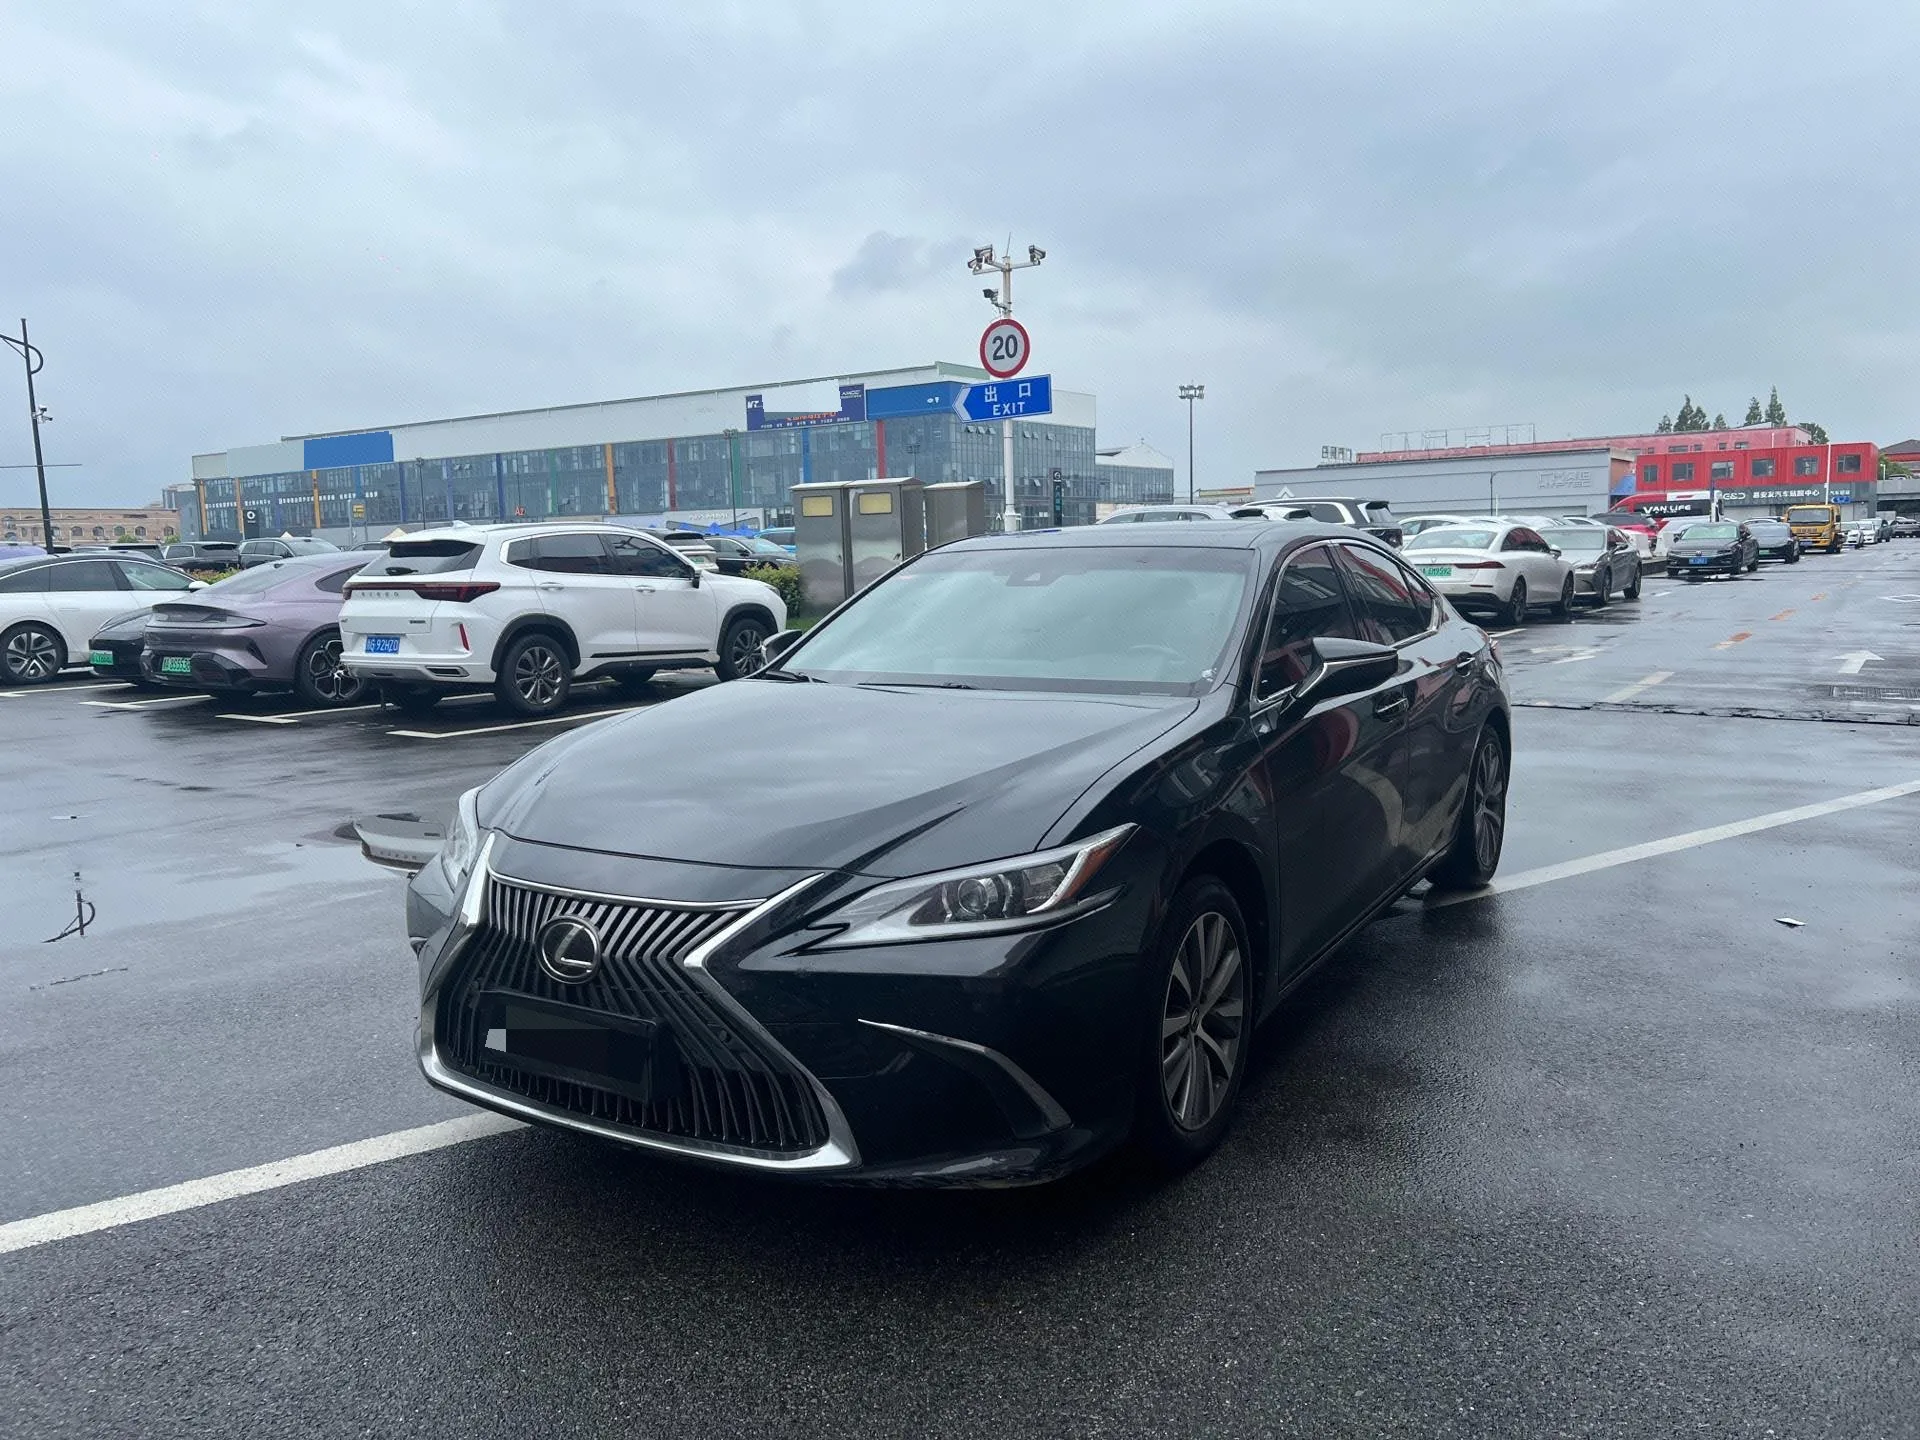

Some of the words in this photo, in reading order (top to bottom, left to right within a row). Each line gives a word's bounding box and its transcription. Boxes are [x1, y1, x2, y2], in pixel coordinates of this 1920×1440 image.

[992, 334, 1018, 361] 20
[984, 383, 1031, 403] 出口
[992, 402, 1026, 416] EXIT
[1643, 505, 1667, 514] VAN
